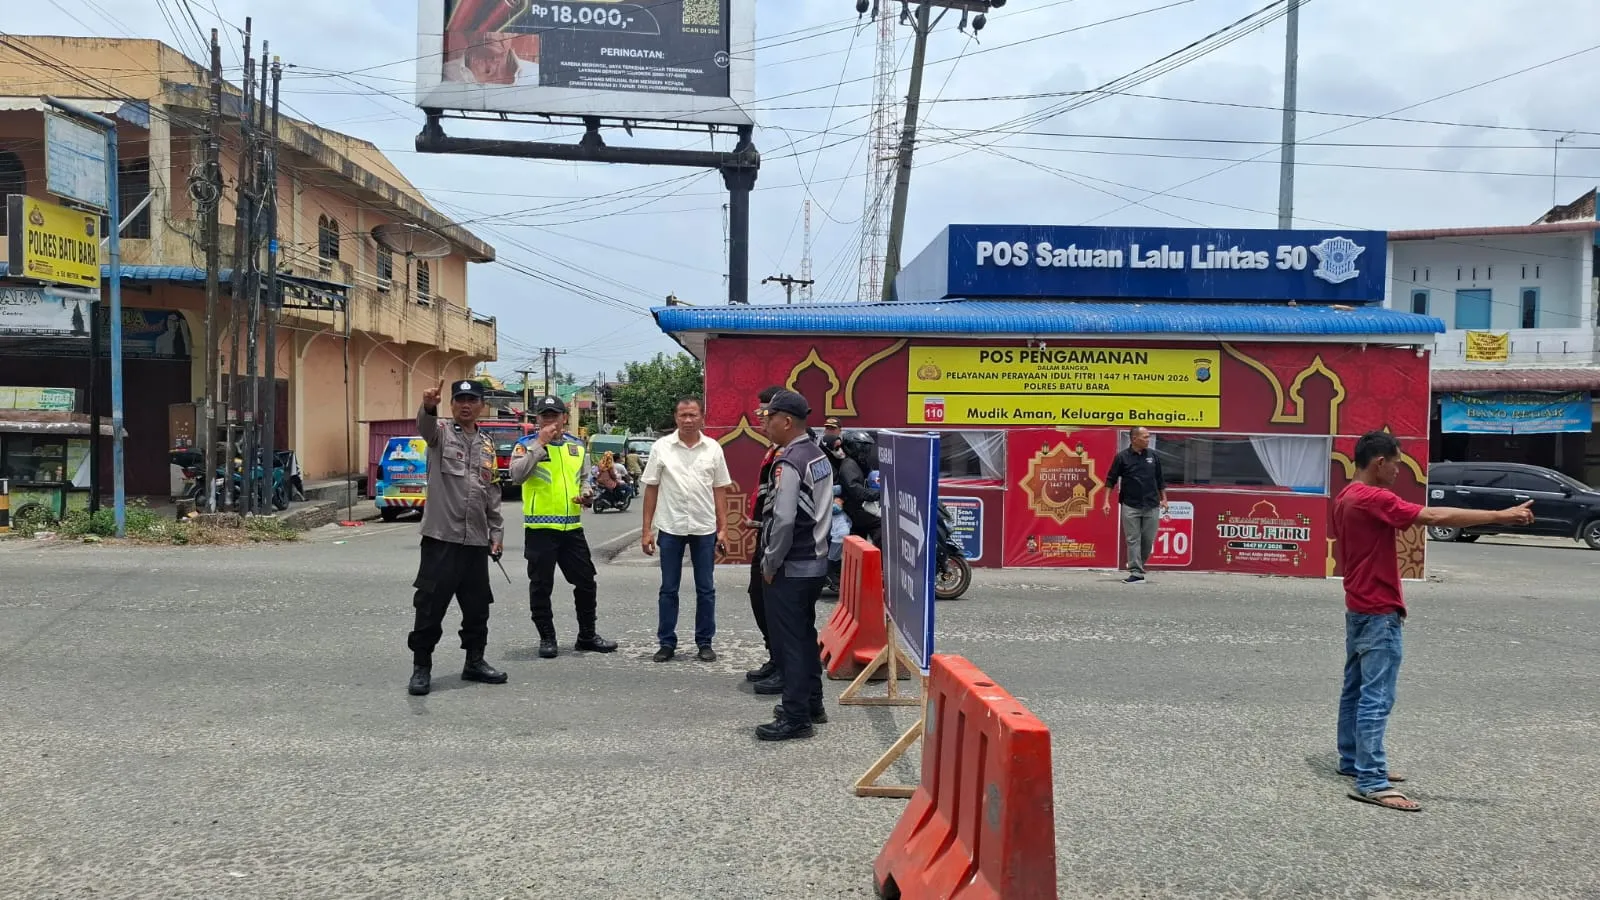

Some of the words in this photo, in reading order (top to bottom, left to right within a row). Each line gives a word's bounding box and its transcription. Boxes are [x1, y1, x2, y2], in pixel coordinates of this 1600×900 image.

[532, 5, 548, 18] Rp
[551, 5, 634, 29] 18.000,-
[600, 47, 665, 59] PERINGATAN:
[29, 229, 57, 259] POLRES
[59, 236, 77, 263] BATU
[79, 240, 97, 266] BARA
[976, 241, 1029, 267] POS
[1036, 241, 1123, 269] Satuan
[1130, 244, 1185, 270] Lalu
[1191, 245, 1269, 271] Lintas
[1276, 245, 1308, 271] 50
[0, 288, 43, 306] ARA
[979, 350, 1015, 364] POS
[1019, 350, 1148, 365] PENGAMANAN
[946, 371, 999, 380] PELAYANAN
[1002, 372, 1049, 381] PERAYAAN
[1050, 372, 1073, 381] IDUL
[1074, 373, 1096, 381] FITRI
[1099, 373, 1121, 381] 1447
[1123, 373, 1130, 381] H
[1132, 373, 1165, 382] TAHUN
[1167, 374, 1190, 382] 2026
[1024, 382, 1057, 391] POLRES
[1059, 383, 1084, 391] BATU
[1086, 383, 1110, 391] BARA
[926, 408, 943, 418] 110
[967, 407, 1009, 420] Mudik
[1013, 408, 1057, 421] Aman,
[1060, 408, 1125, 422] Keluarga
[1128, 409, 1204, 423] Bahagia...!
[1040, 473, 1057, 481] IDUL
[1059, 473, 1079, 481] FITRI
[1216, 523, 1262, 538] IDUL
[1263, 525, 1311, 541] FITRI
